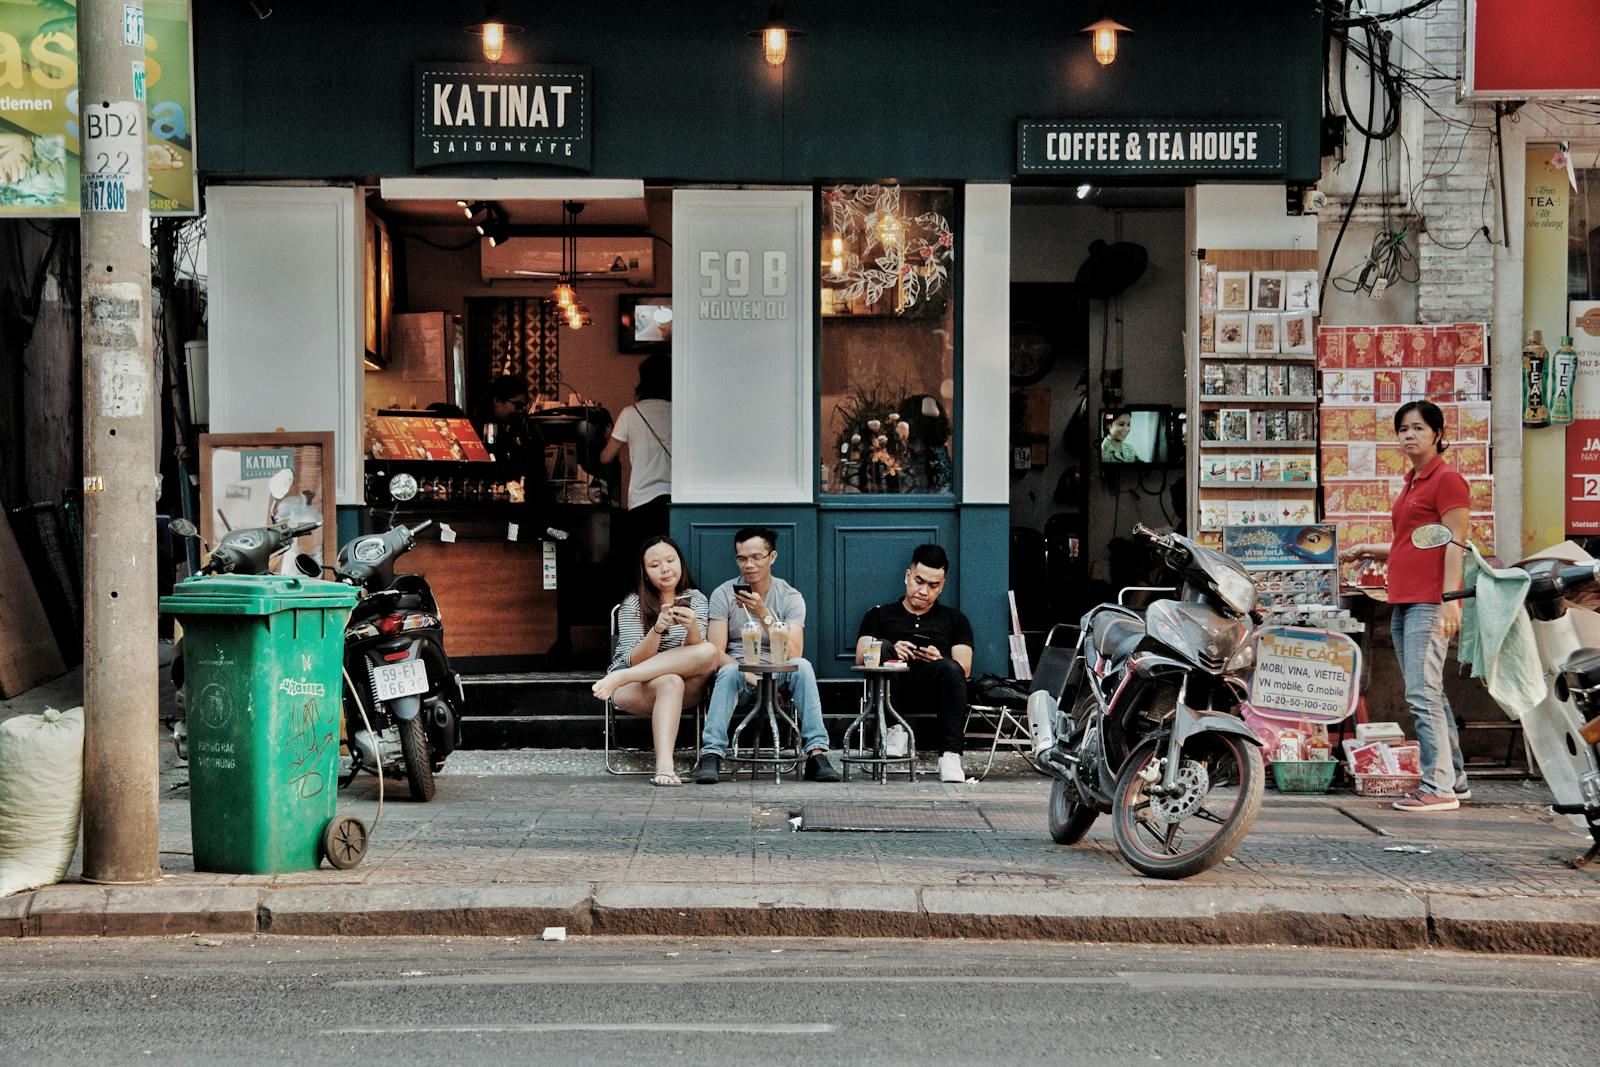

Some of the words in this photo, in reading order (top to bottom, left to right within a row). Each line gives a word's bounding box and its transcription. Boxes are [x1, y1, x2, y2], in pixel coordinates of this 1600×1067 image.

[433, 83, 572, 128] KATINAT
[88, 113, 138, 140] BD2
[1046, 132, 1120, 161] COFFEE
[1125, 132, 1142, 161] &
[1147, 132, 1185, 161] TEA
[1190, 132, 1258, 161] HOUSE
[96, 151, 130, 175] 22
[699, 250, 750, 298] 59
[762, 250, 787, 298] B
[699, 300, 762, 321] NGUYEN
[765, 300, 787, 321] DU
[246, 455, 289, 469] KATINAT
[1260, 662, 1285, 675] MOBI,
[1288, 665, 1311, 678] VINA,
[1314, 668, 1346, 682] VIETTEL
[1259, 678, 1272, 687] VN
[1273, 680, 1304, 693] mobile,
[1307, 683, 1344, 697] G.mobile
[1263, 694, 1338, 712] 10-20-50-100-200
